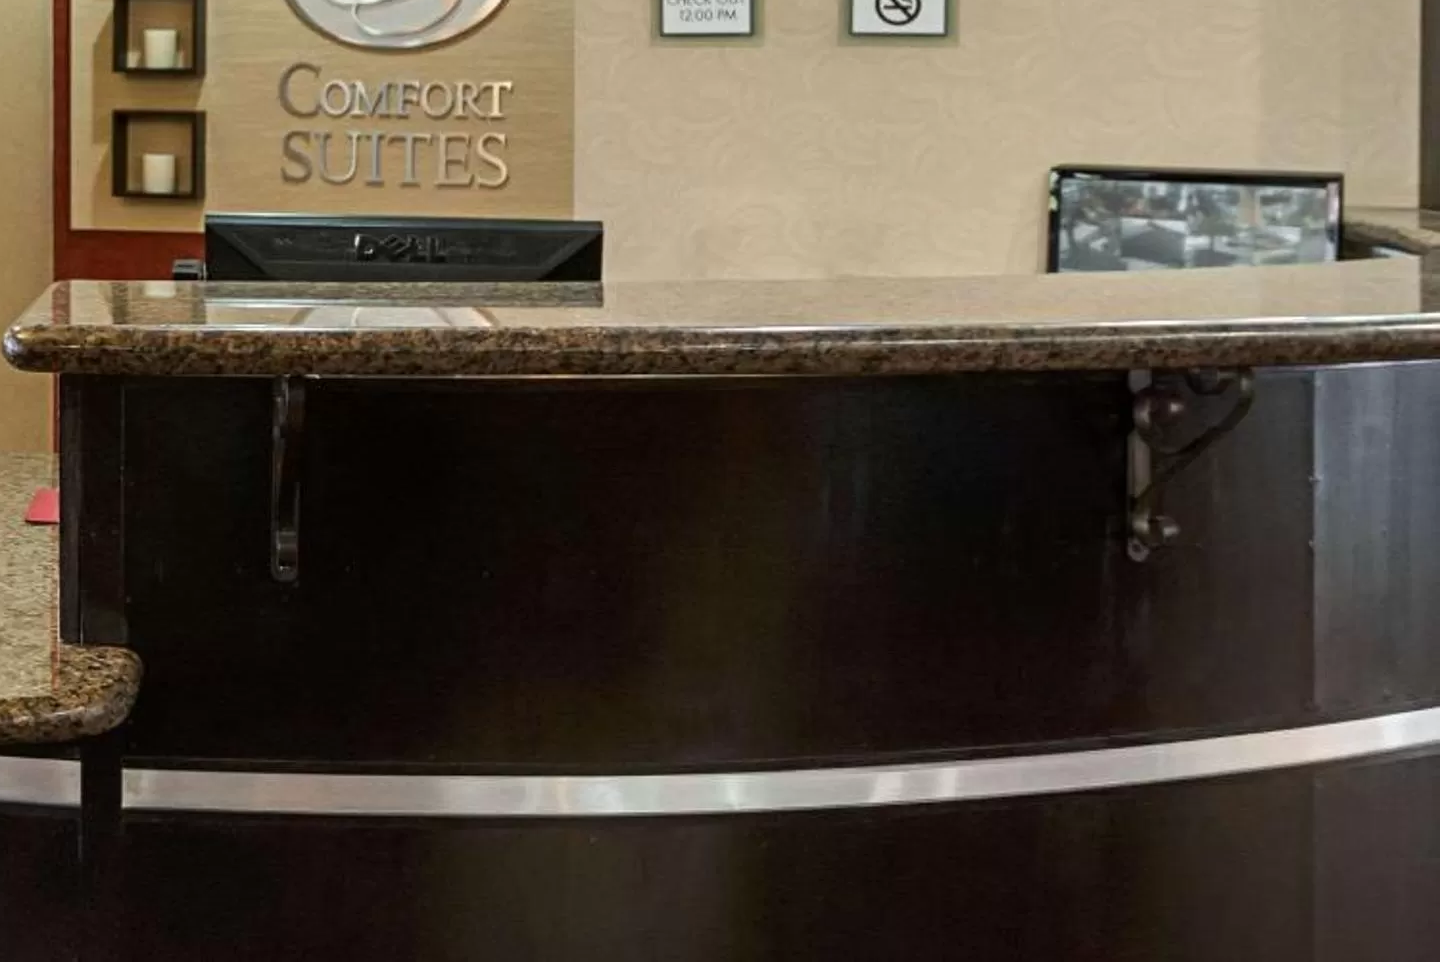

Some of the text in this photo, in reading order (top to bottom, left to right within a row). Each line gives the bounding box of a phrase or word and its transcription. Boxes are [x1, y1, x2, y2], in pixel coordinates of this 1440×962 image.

[717, 8, 737, 22] PM
[281, 130, 509, 189] SUITES
[353, 234, 448, 264] DELL
